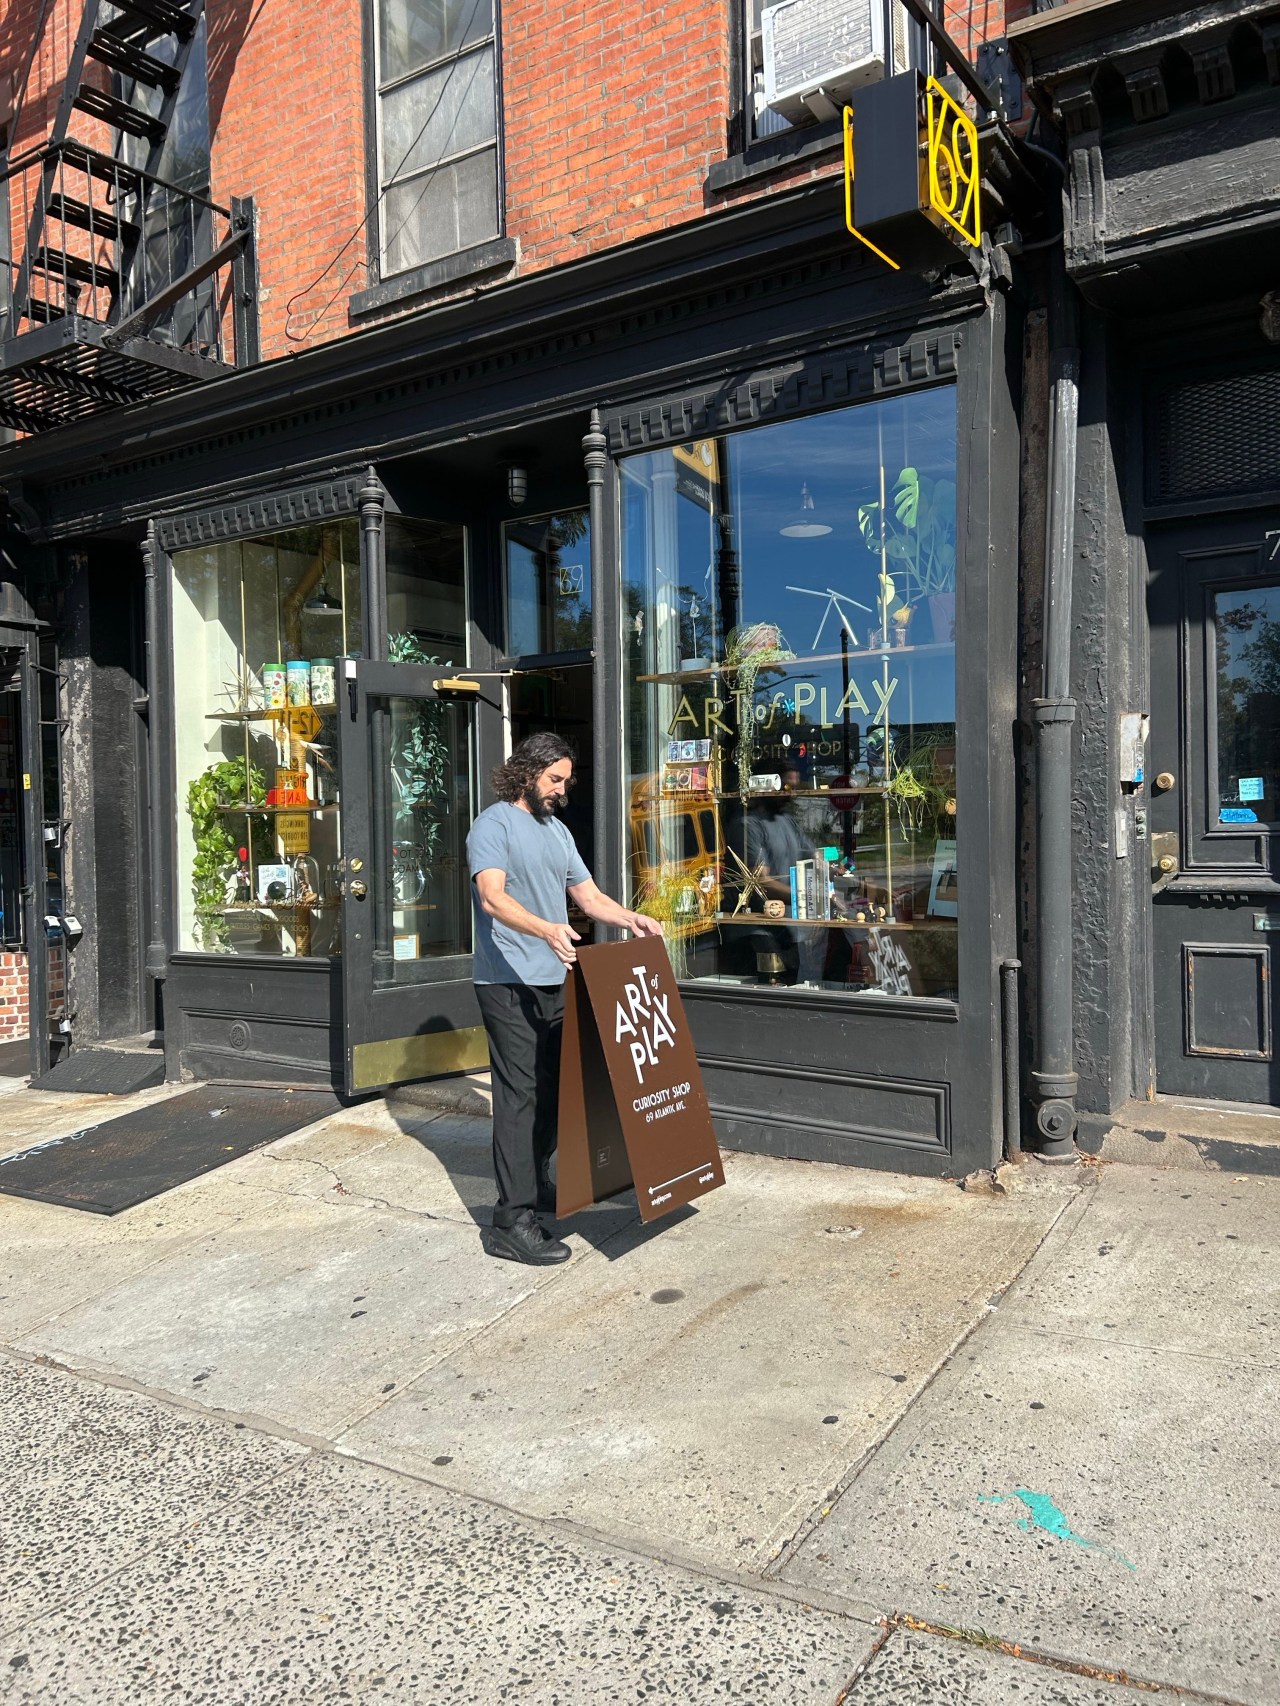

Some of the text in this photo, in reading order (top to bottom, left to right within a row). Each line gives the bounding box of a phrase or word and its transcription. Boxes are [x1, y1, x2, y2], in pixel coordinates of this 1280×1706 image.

[931, 97, 979, 227] 69
[560, 566, 583, 595] 69
[668, 677, 899, 736] ART of PLAY
[716, 743, 792, 763] COSITY
[650, 973, 660, 990] of
[615, 965, 652, 1044] ART
[630, 993, 677, 1085] PLAY
[632, 1081, 691, 1112] CURIOSITY SHOP
[645, 1111, 654, 1123] 69
[654, 1103, 676, 1120] ATLANTIC
